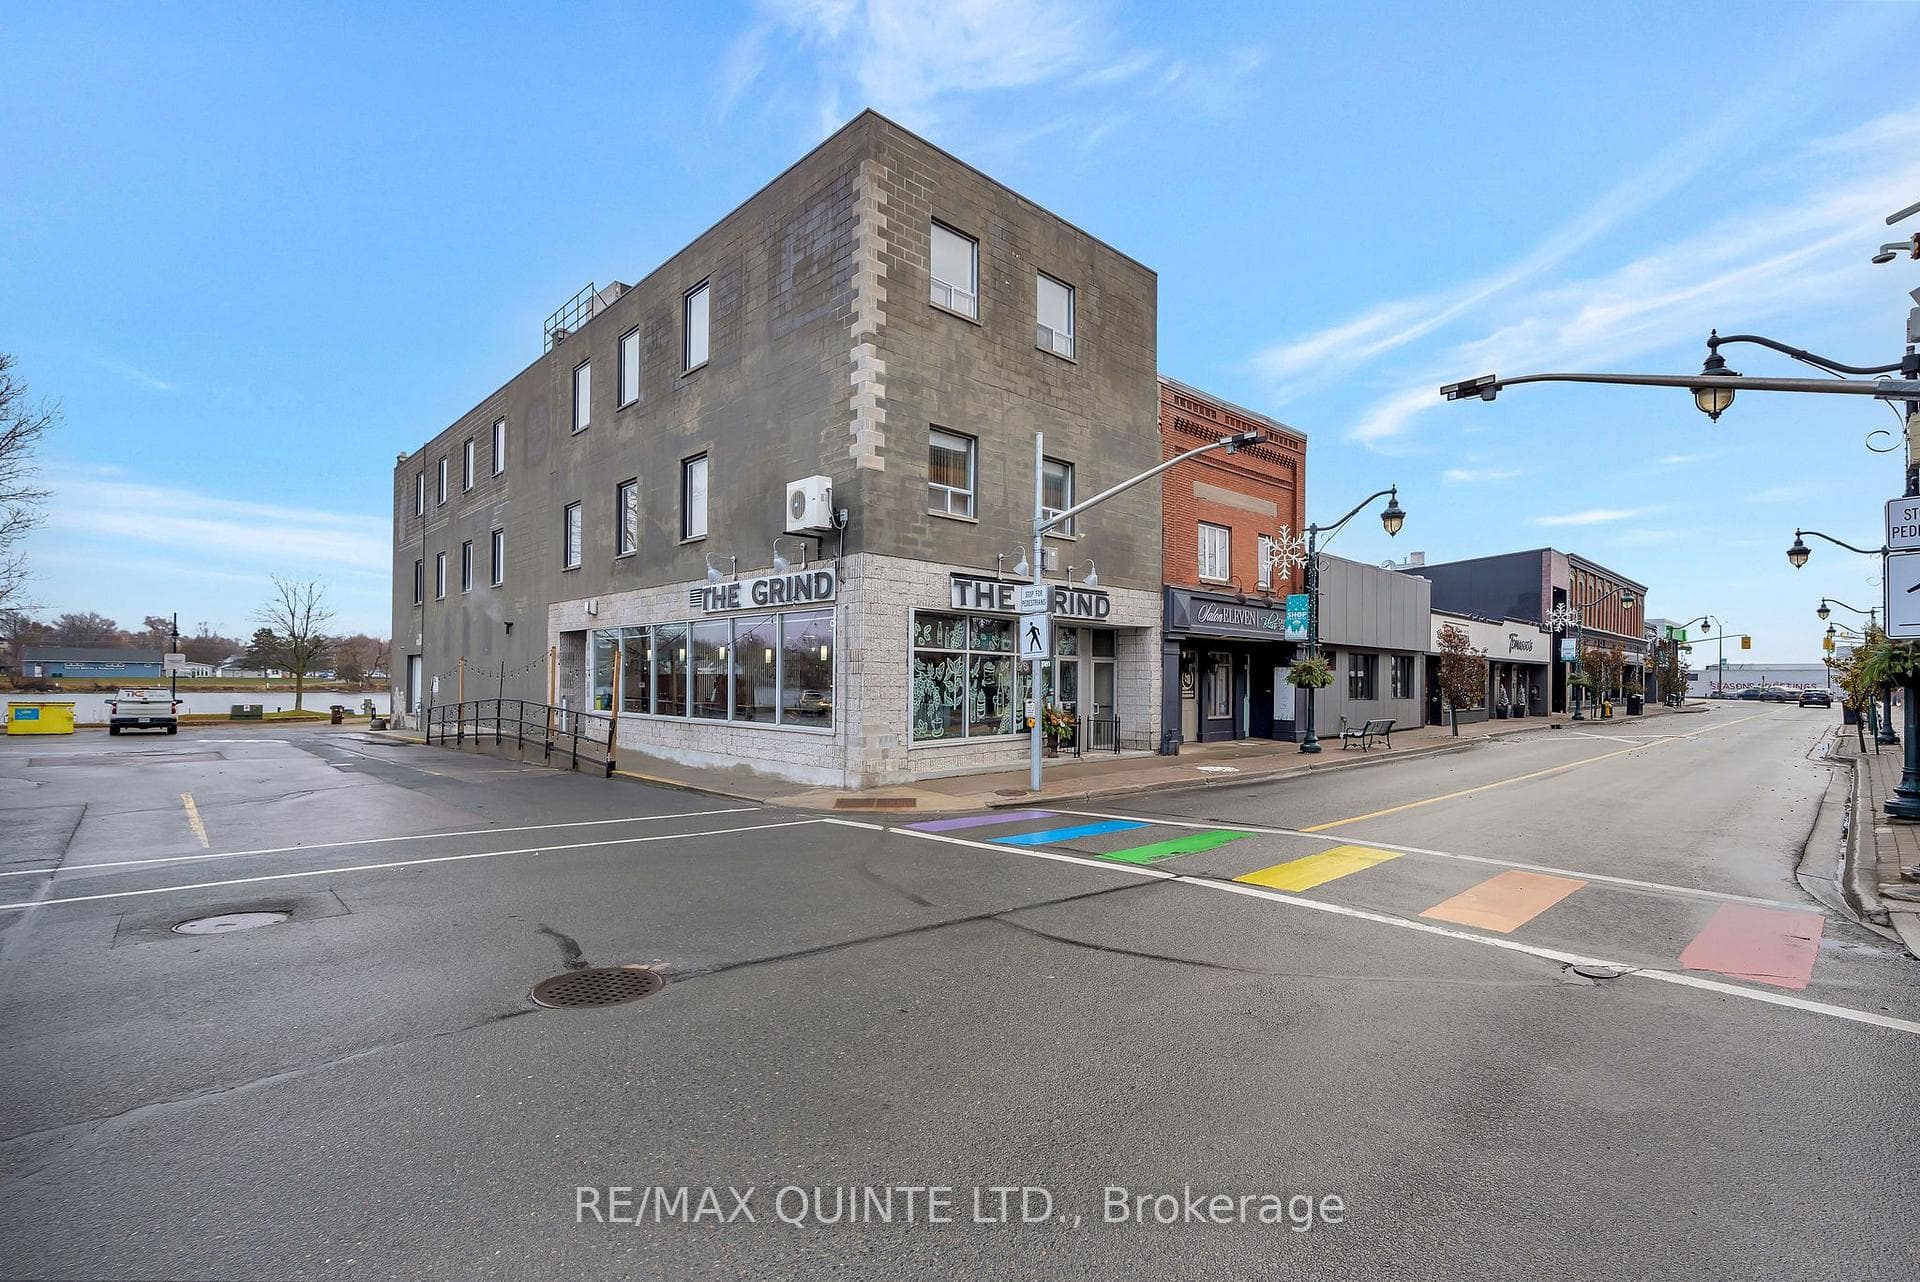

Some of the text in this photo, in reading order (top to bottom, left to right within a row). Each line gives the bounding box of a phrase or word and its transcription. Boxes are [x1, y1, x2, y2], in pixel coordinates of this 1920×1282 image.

[1904, 507, 1920, 521] ST
[1892, 524, 1920, 539] PED
[701, 571, 833, 611] THE GRIND
[954, 579, 1111, 618] THE RIND
[1198, 603, 1223, 623] Salon
[1223, 607, 1256, 626] ELEVEN
